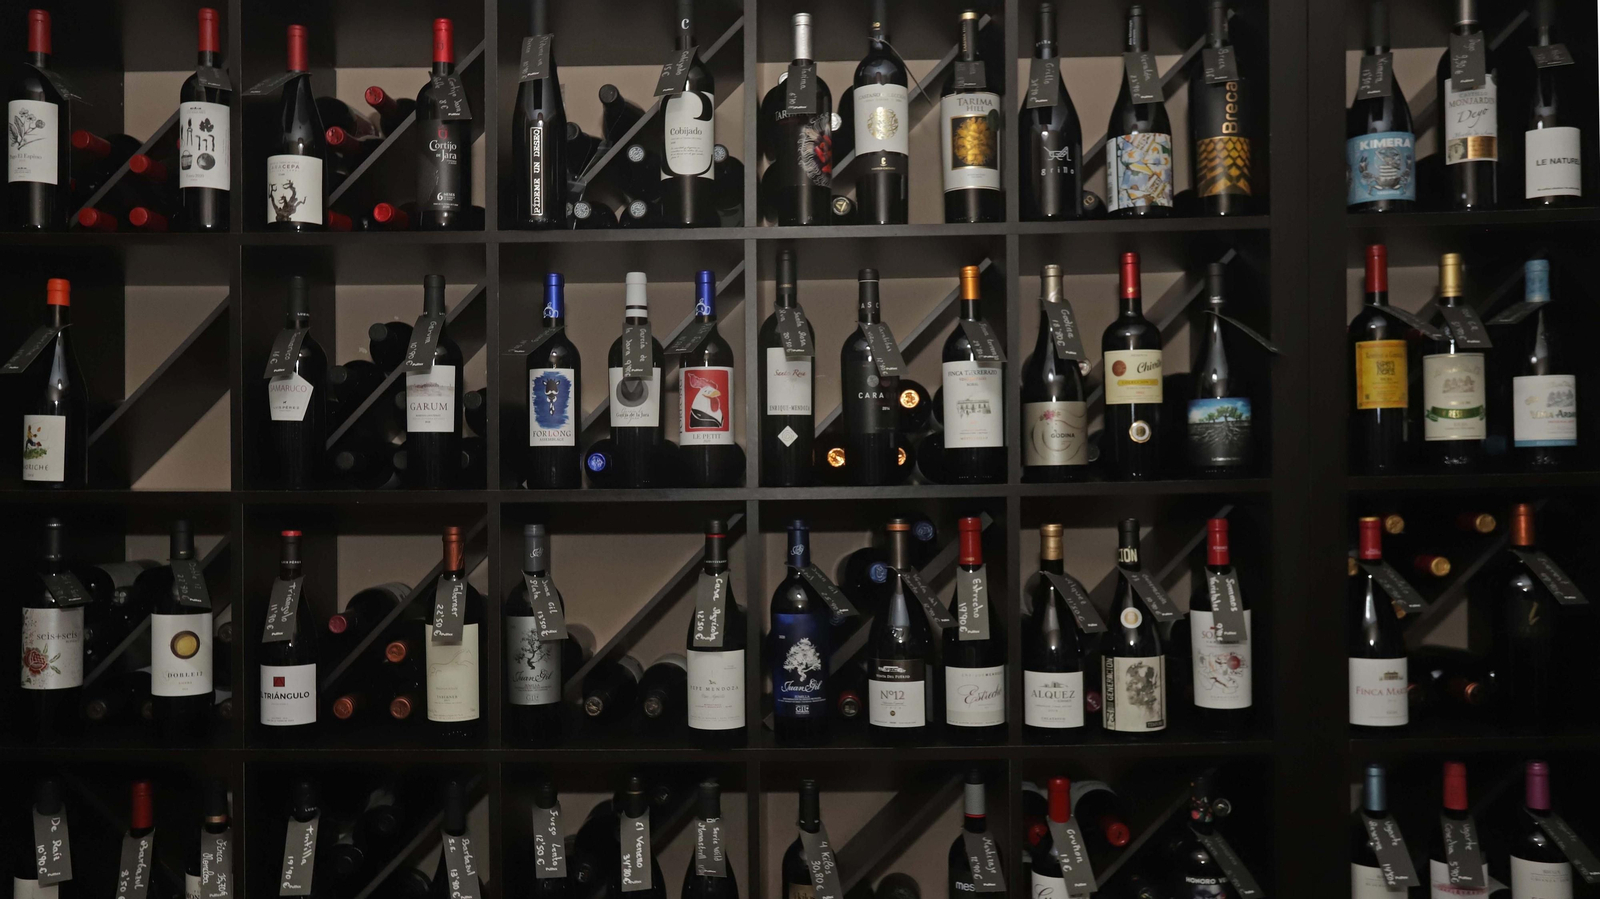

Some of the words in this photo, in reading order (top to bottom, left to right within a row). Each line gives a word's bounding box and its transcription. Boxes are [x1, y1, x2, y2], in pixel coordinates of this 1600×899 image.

[956, 97, 993, 107] TARIMA
[966, 105, 985, 113] HILL
[1221, 81, 1238, 135] Breca
[669, 127, 703, 137] Cobijado
[429, 139, 457, 152] Cortijo
[1359, 138, 1411, 151] KIMERA
[440, 150, 457, 161] Jara
[1535, 158, 1549, 166] LE
[409, 402, 449, 411] GARUM
[531, 430, 573, 438] FORLONG
[264, 690, 311, 701] TRIÁNGULO
[1030, 689, 1076, 700] ALQUEZ
